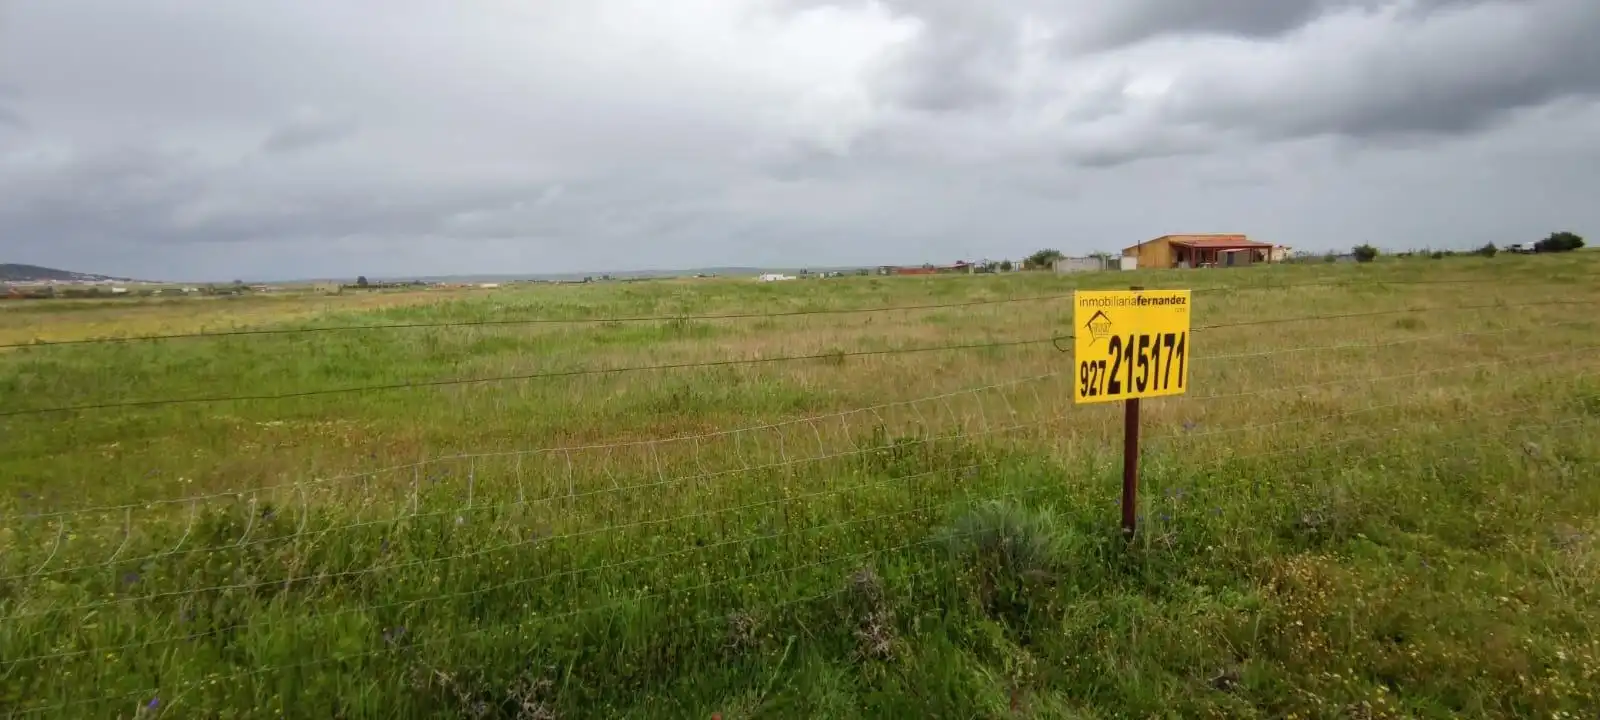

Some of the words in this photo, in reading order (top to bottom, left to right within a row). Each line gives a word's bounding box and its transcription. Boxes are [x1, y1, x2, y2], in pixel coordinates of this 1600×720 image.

[1080, 295, 1186, 307] inmobiliariafernandez
[1080, 360, 1106, 397] 927
[1107, 331, 1185, 395] 215171
